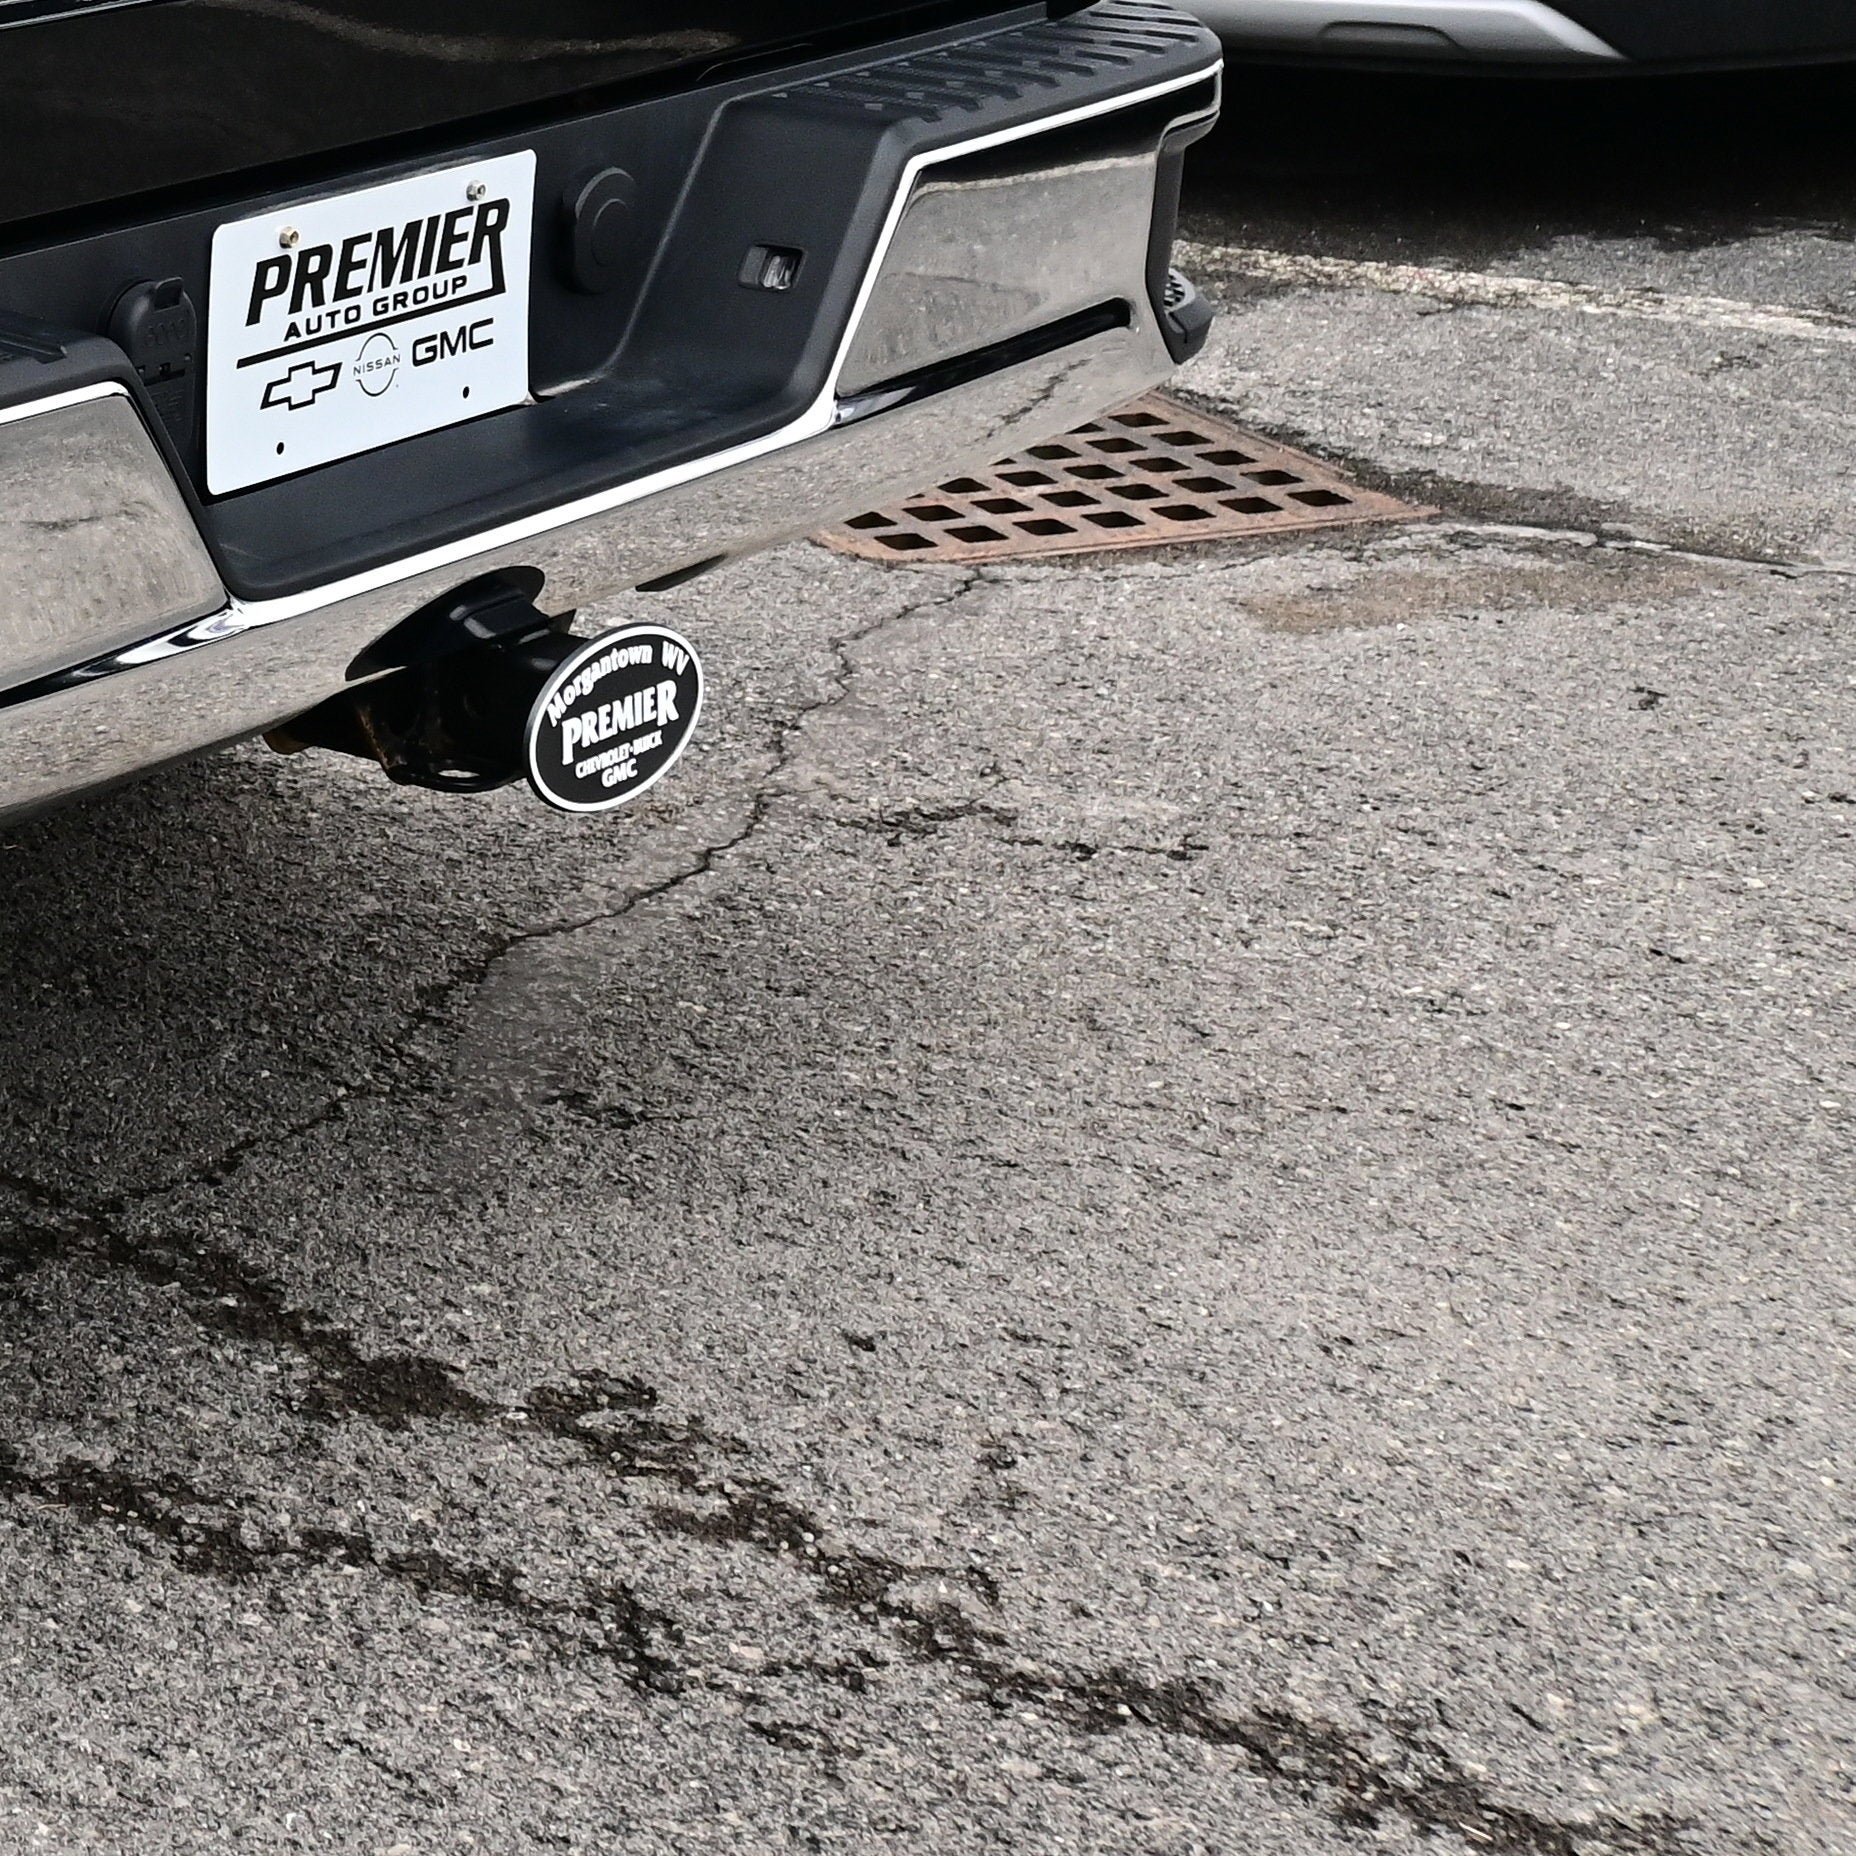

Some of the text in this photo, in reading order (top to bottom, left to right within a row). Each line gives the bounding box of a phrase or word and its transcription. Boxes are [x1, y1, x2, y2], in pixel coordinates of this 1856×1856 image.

[245, 197, 510, 327] PREMIER
[284, 274, 468, 342] AUTO GROUP
[353, 317, 494, 376] NISSAN GMC
[547, 640, 690, 728] Morgantown WV
[562, 679, 680, 766] PREMIER
[601, 758, 638, 788] GMC
